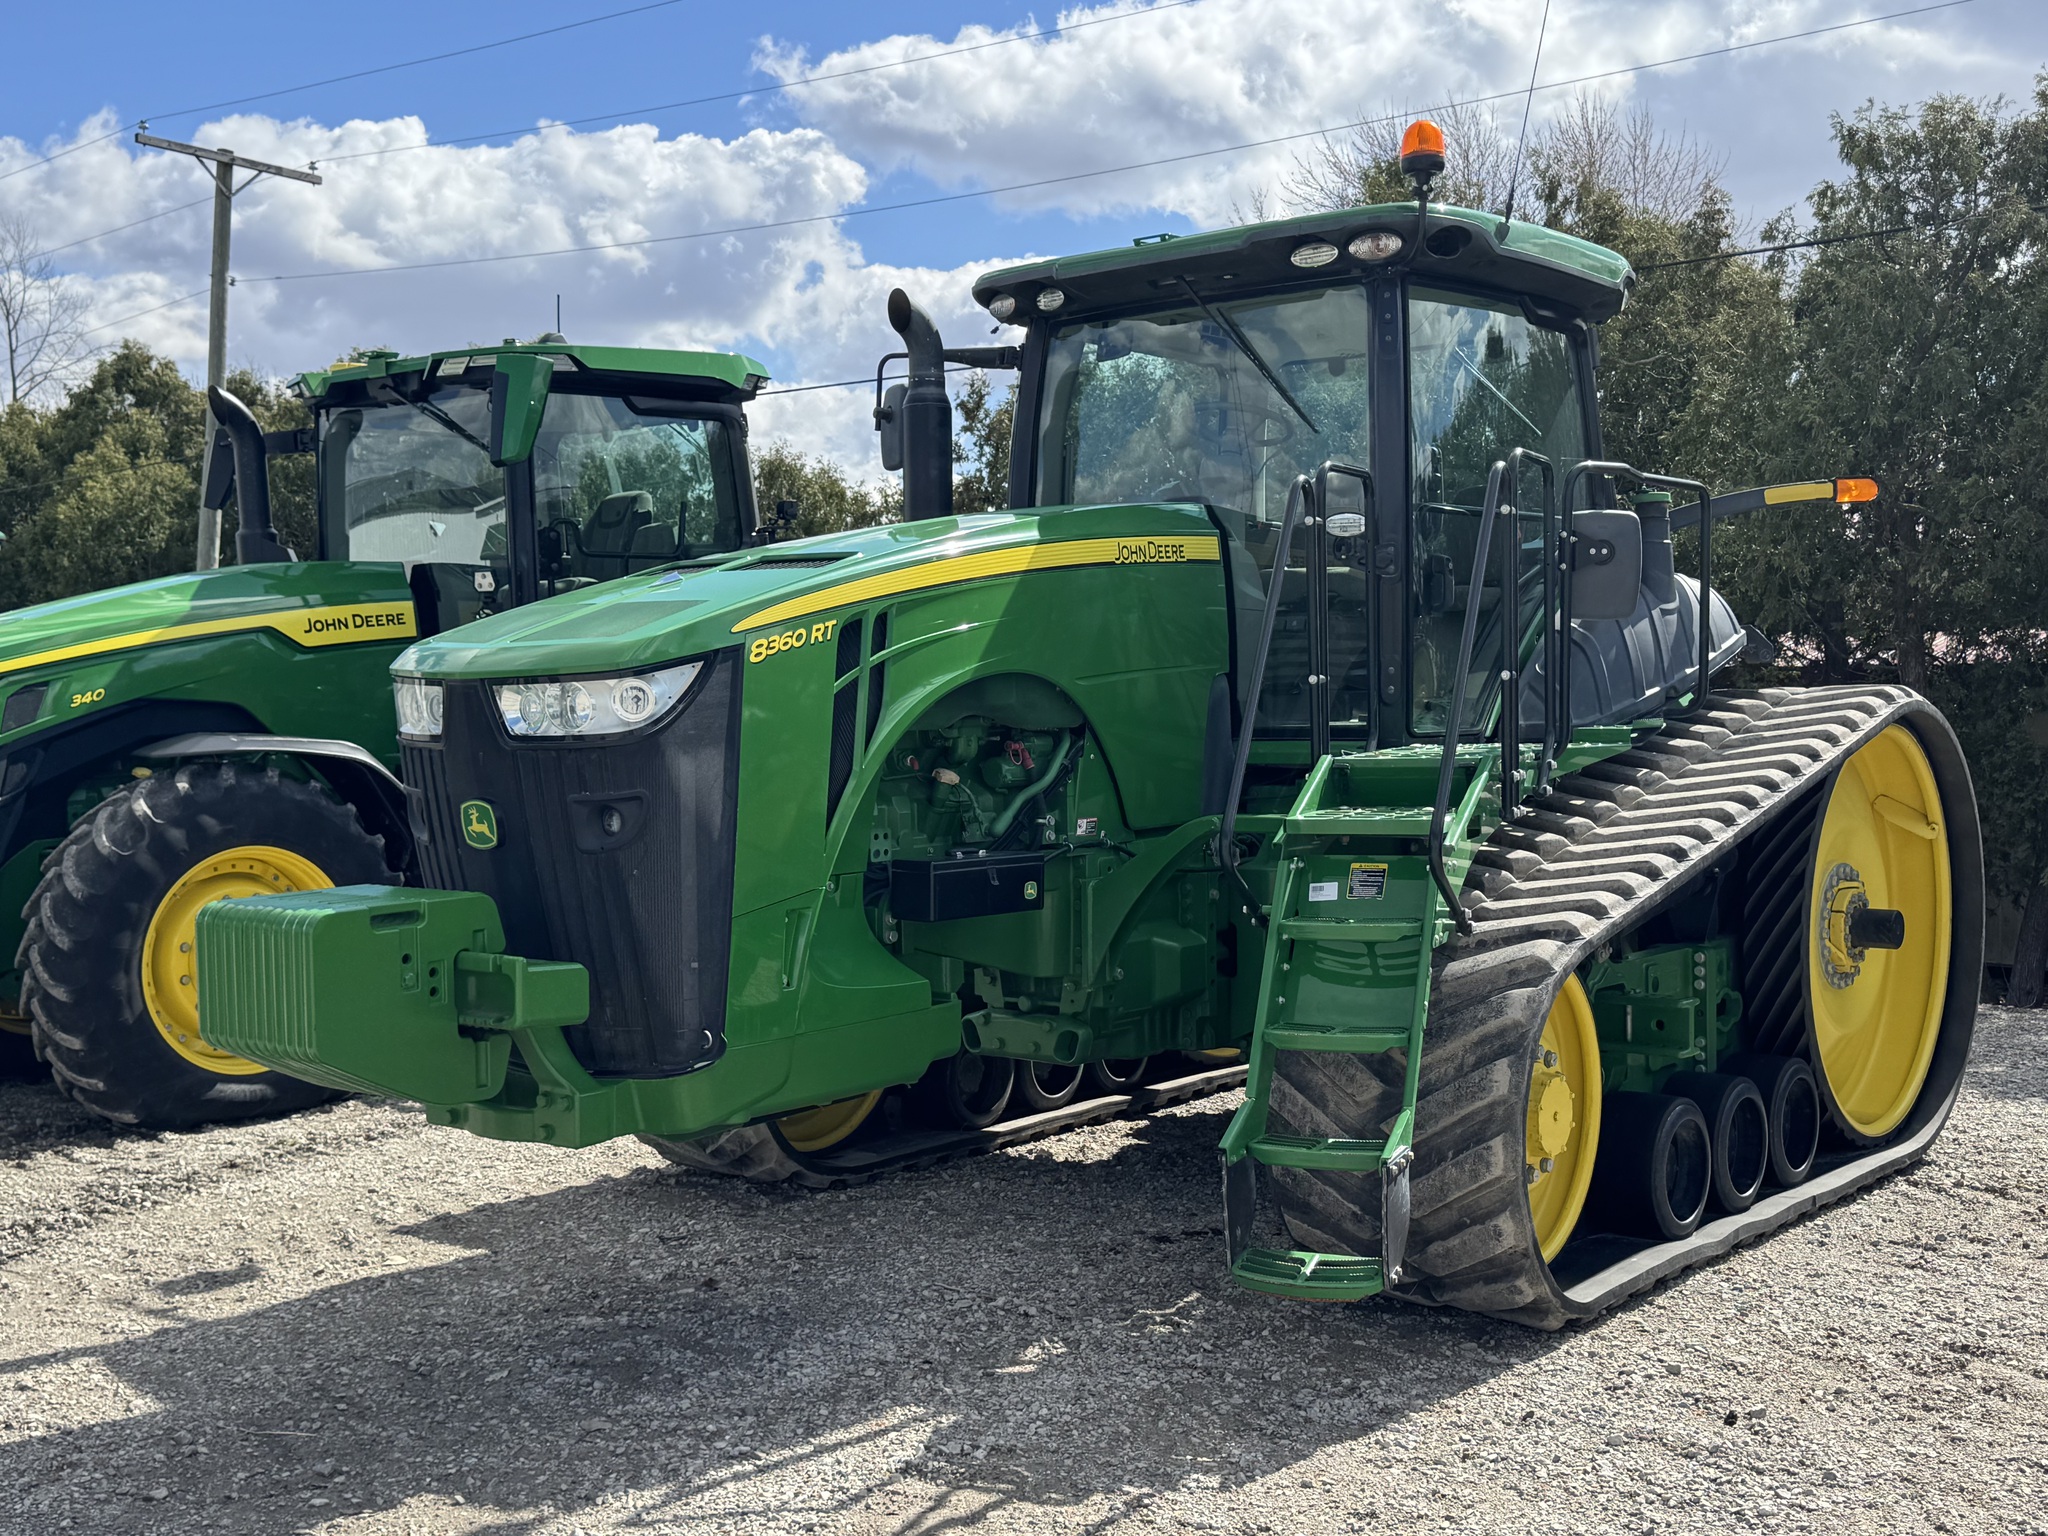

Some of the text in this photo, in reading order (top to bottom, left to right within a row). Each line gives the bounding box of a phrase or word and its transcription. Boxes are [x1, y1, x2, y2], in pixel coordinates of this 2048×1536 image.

[1115, 541, 1186, 562] JOHN DEERE
[304, 613, 406, 634] JOHN DEERE
[749, 619, 838, 663] 8360 RT
[70, 688, 106, 708] 340
